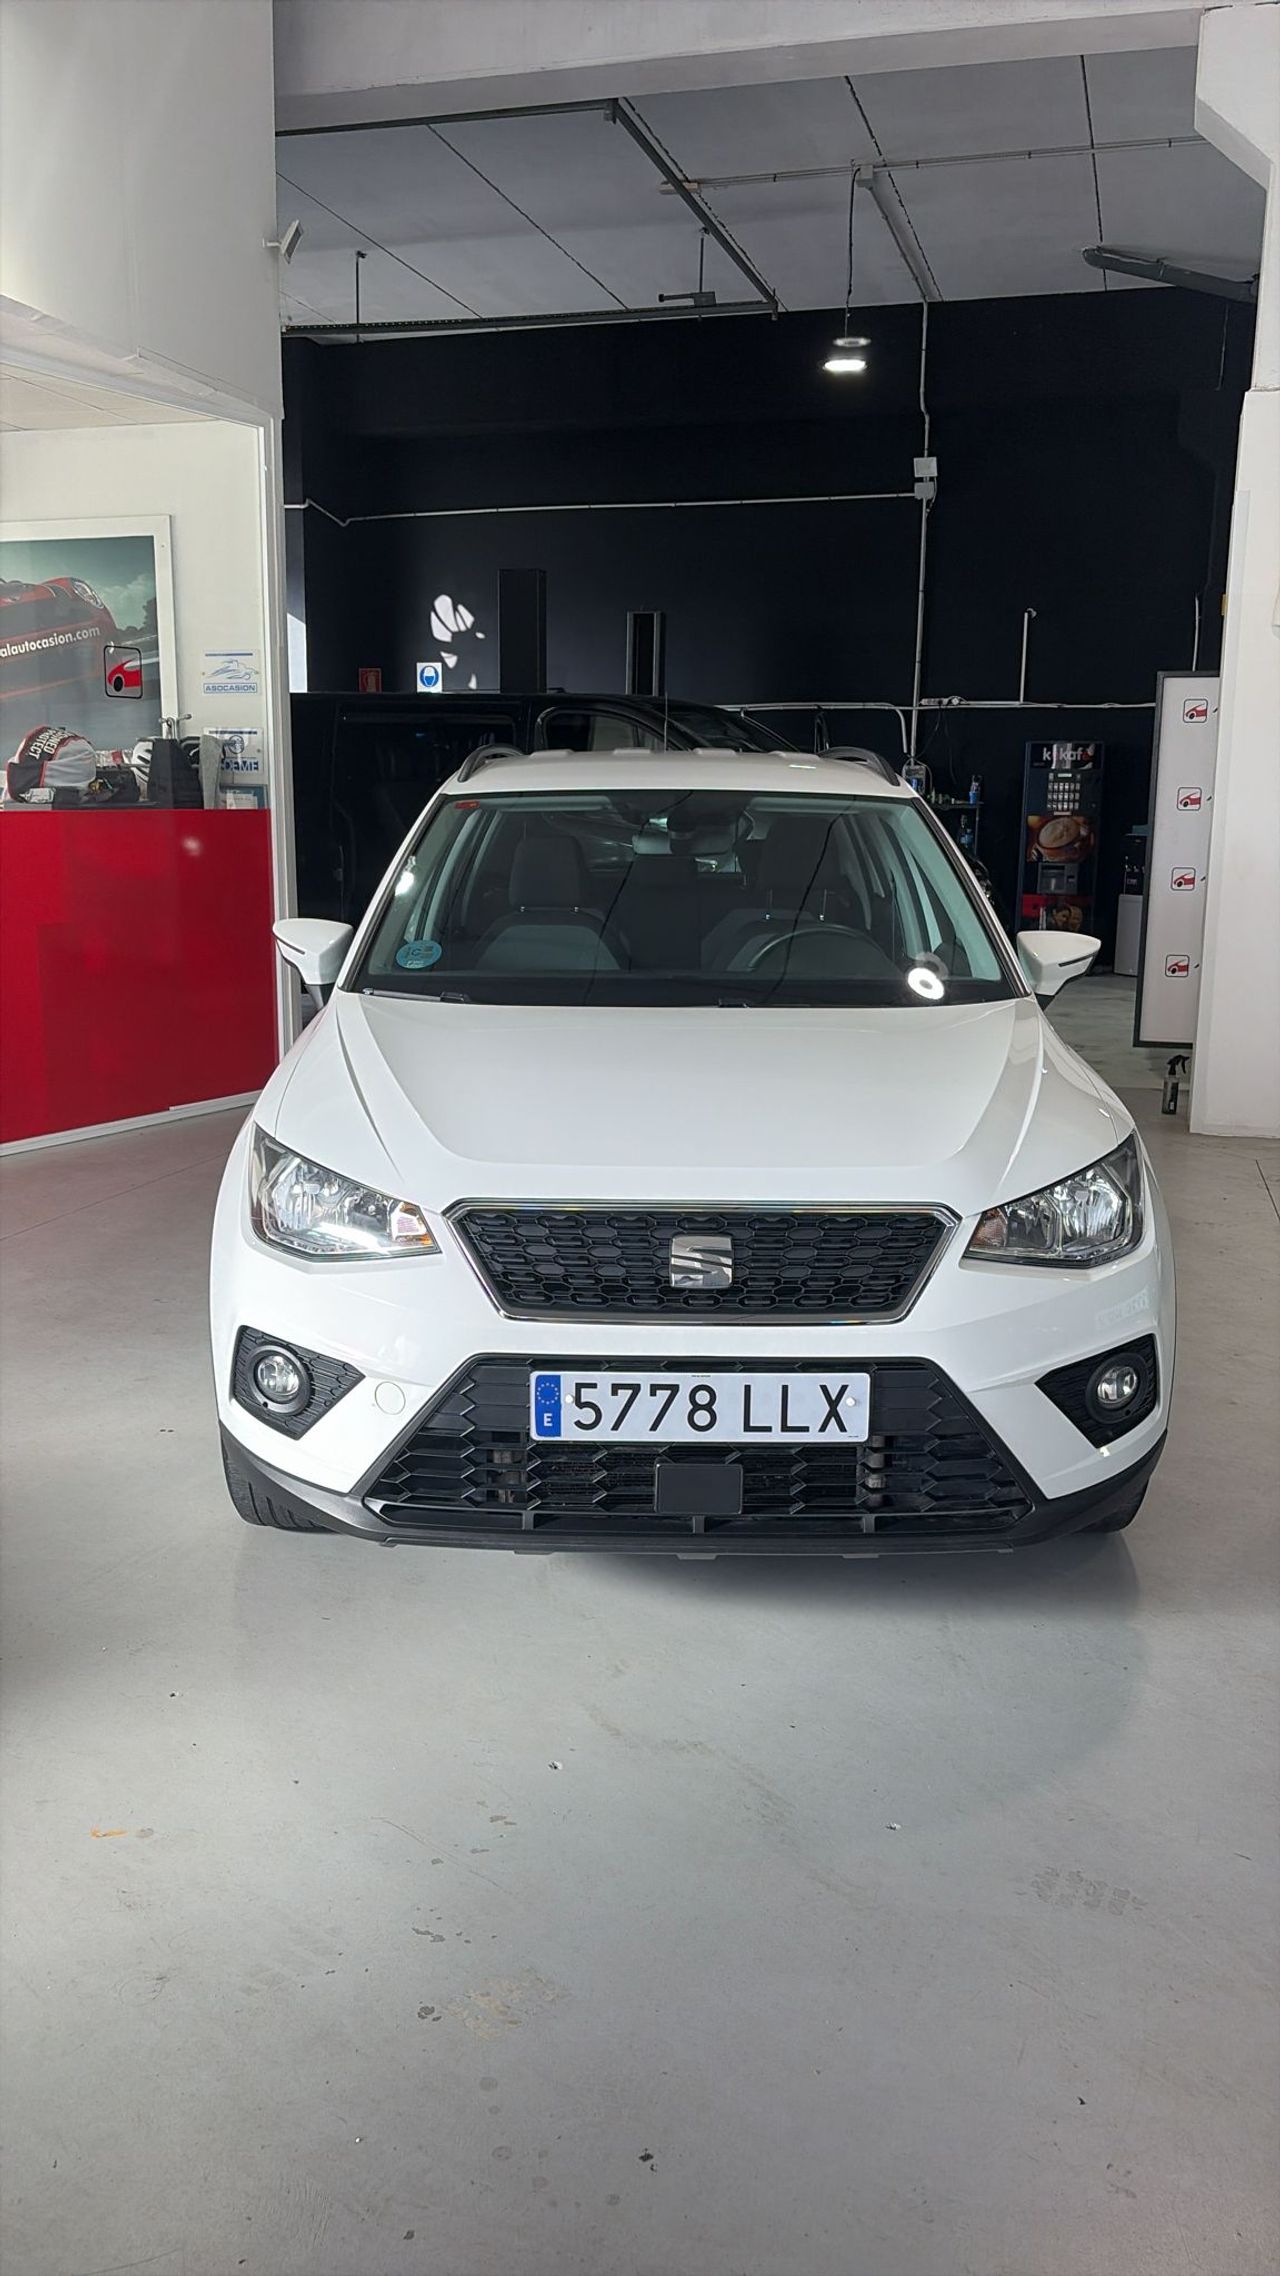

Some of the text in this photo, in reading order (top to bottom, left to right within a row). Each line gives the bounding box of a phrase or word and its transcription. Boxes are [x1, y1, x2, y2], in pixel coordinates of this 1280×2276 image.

[205, 684, 257, 692] ASOCASION
[573, 1382, 850, 1434] 5778 LLX
[543, 1413, 553, 1427] E
